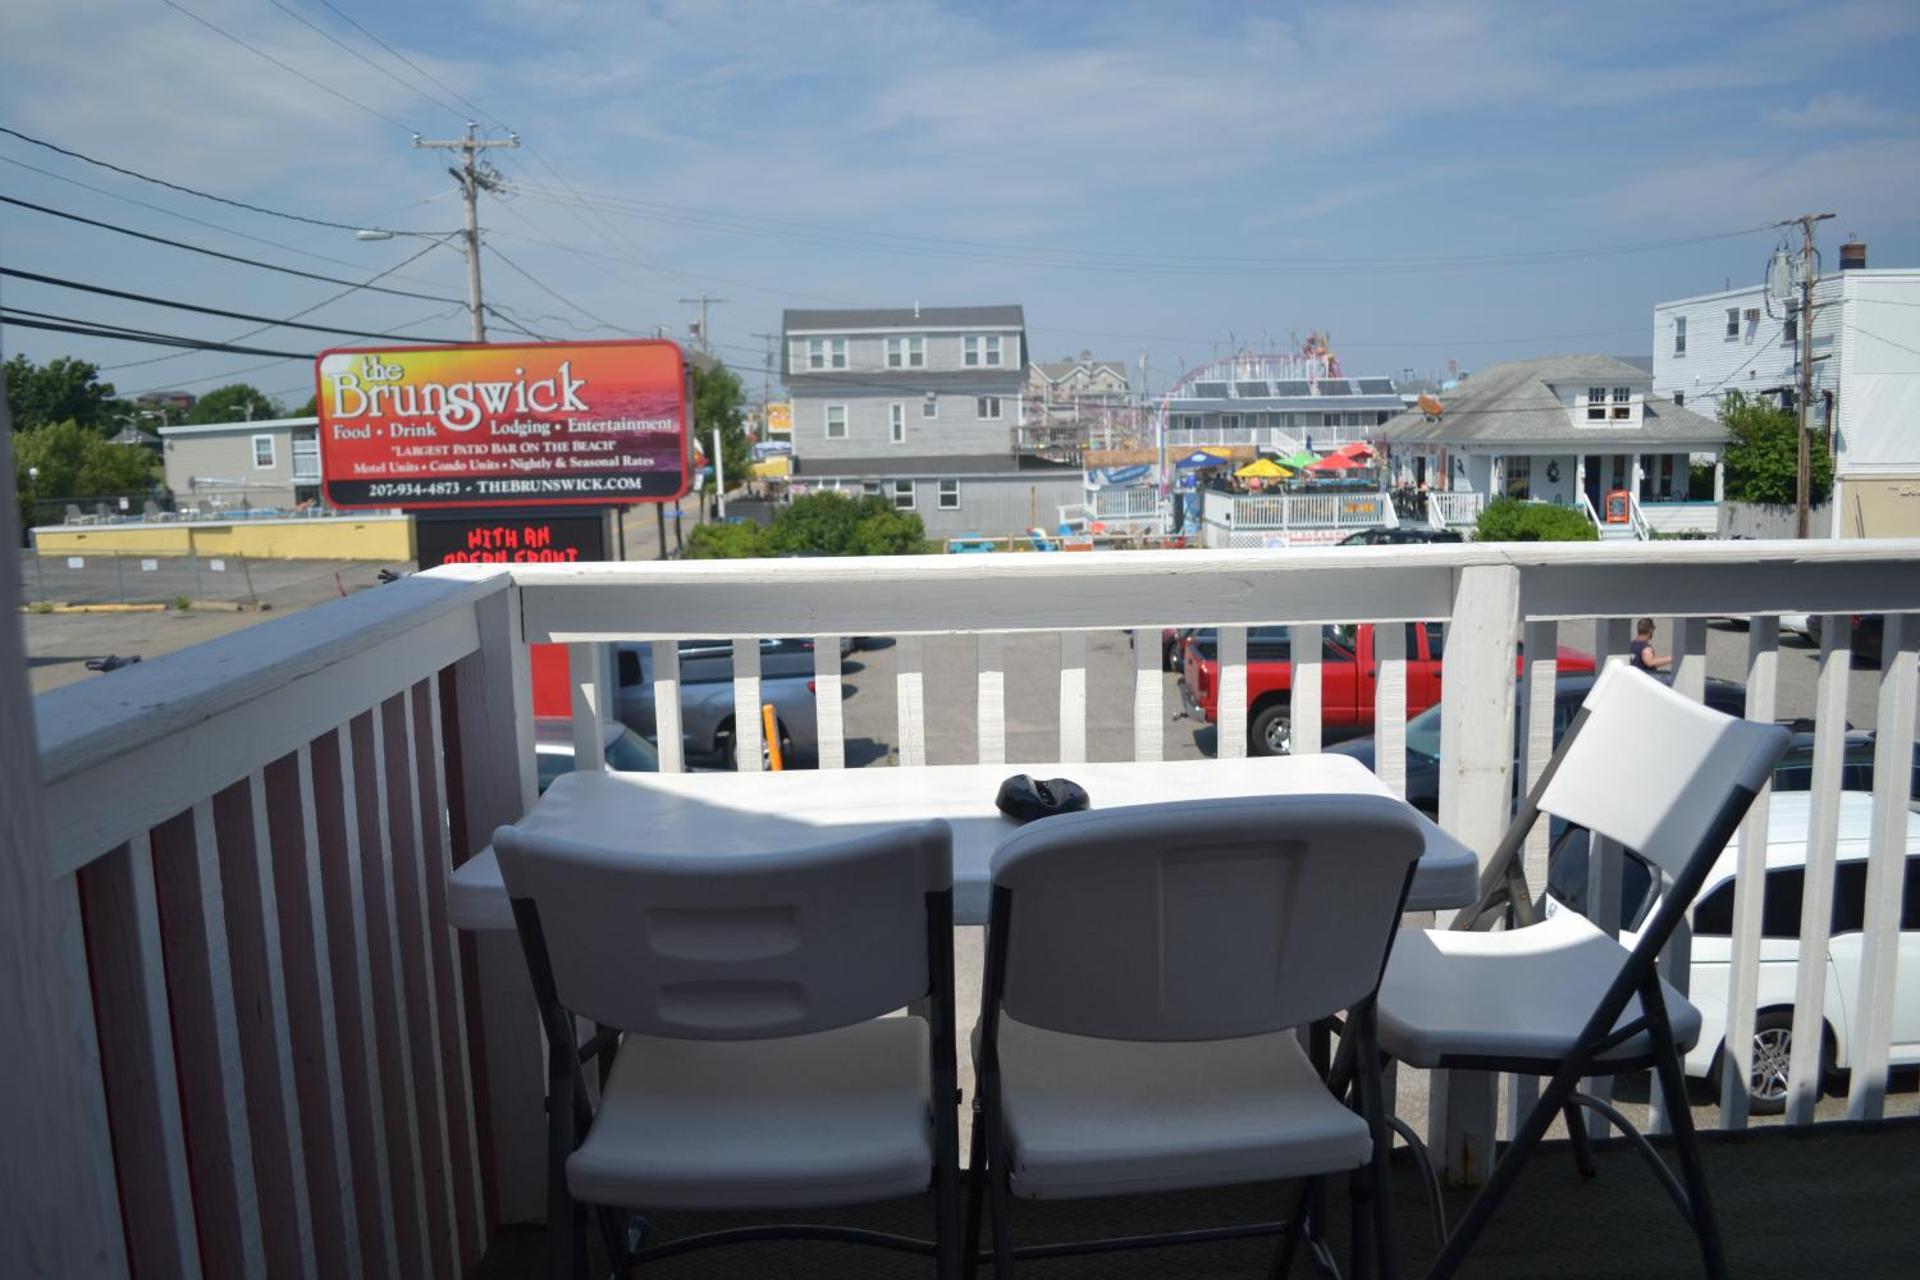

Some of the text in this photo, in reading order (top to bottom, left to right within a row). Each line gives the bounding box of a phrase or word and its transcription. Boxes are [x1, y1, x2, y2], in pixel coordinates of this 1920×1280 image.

[361, 355, 404, 380] the
[328, 360, 590, 432] Brunswick
[333, 417, 673, 439] Food Drink Lodging Entertainment
[452, 444, 489, 455] PATIO
[491, 443, 517, 454] BAR
[520, 442, 540, 452] ON
[542, 441, 570, 452] THE
[354, 455, 655, 473] Motel Units Condo Units Nightly & Seasonal Rates
[369, 482, 460, 497] 207-934-4873
[476, 477, 642, 493] THEBRUNSWICK.COM
[468, 525, 550, 549] WITH AN
